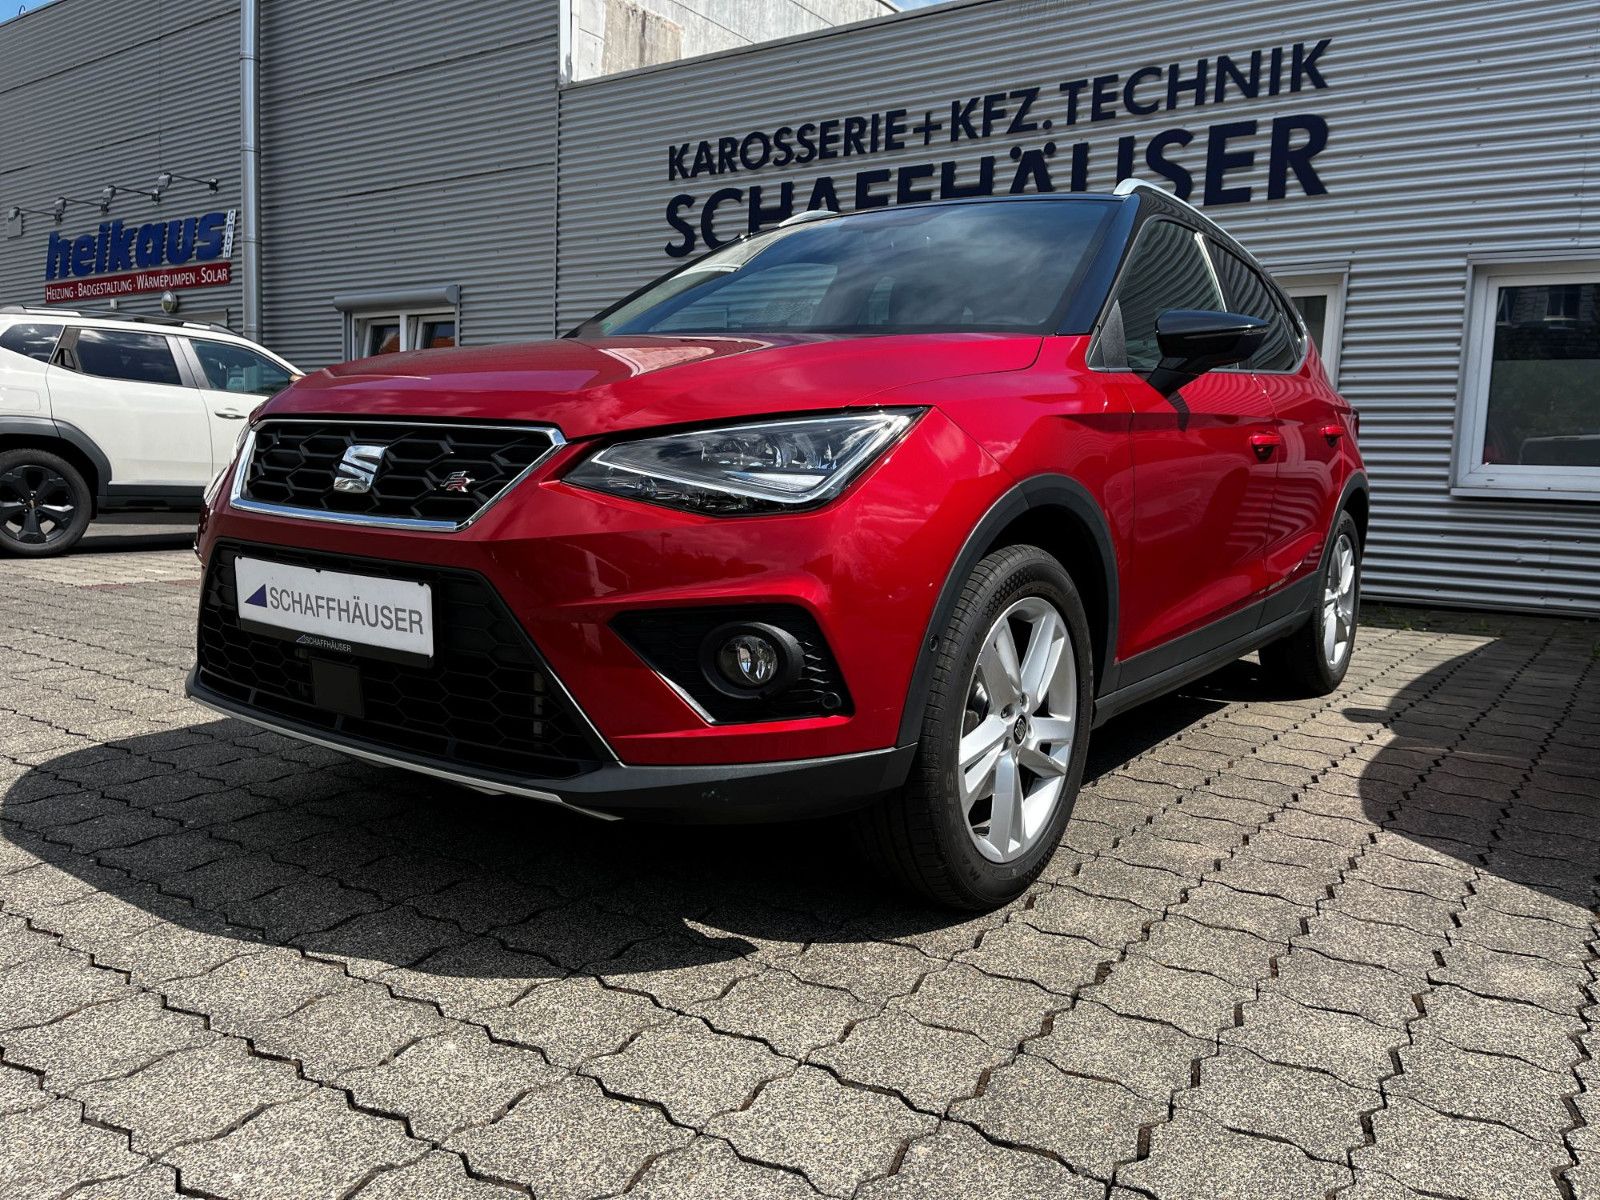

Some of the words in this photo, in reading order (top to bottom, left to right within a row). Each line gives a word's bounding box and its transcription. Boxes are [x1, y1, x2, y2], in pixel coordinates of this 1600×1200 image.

[45, 212, 226, 281] heikaus
[78, 279, 132, 297] BADGESTALTUNG
[201, 267, 228, 283] SOLAR
[269, 586, 424, 635] SCHAFFHÄUSER
[304, 636, 352, 652] SCHAFFHÄUSER
